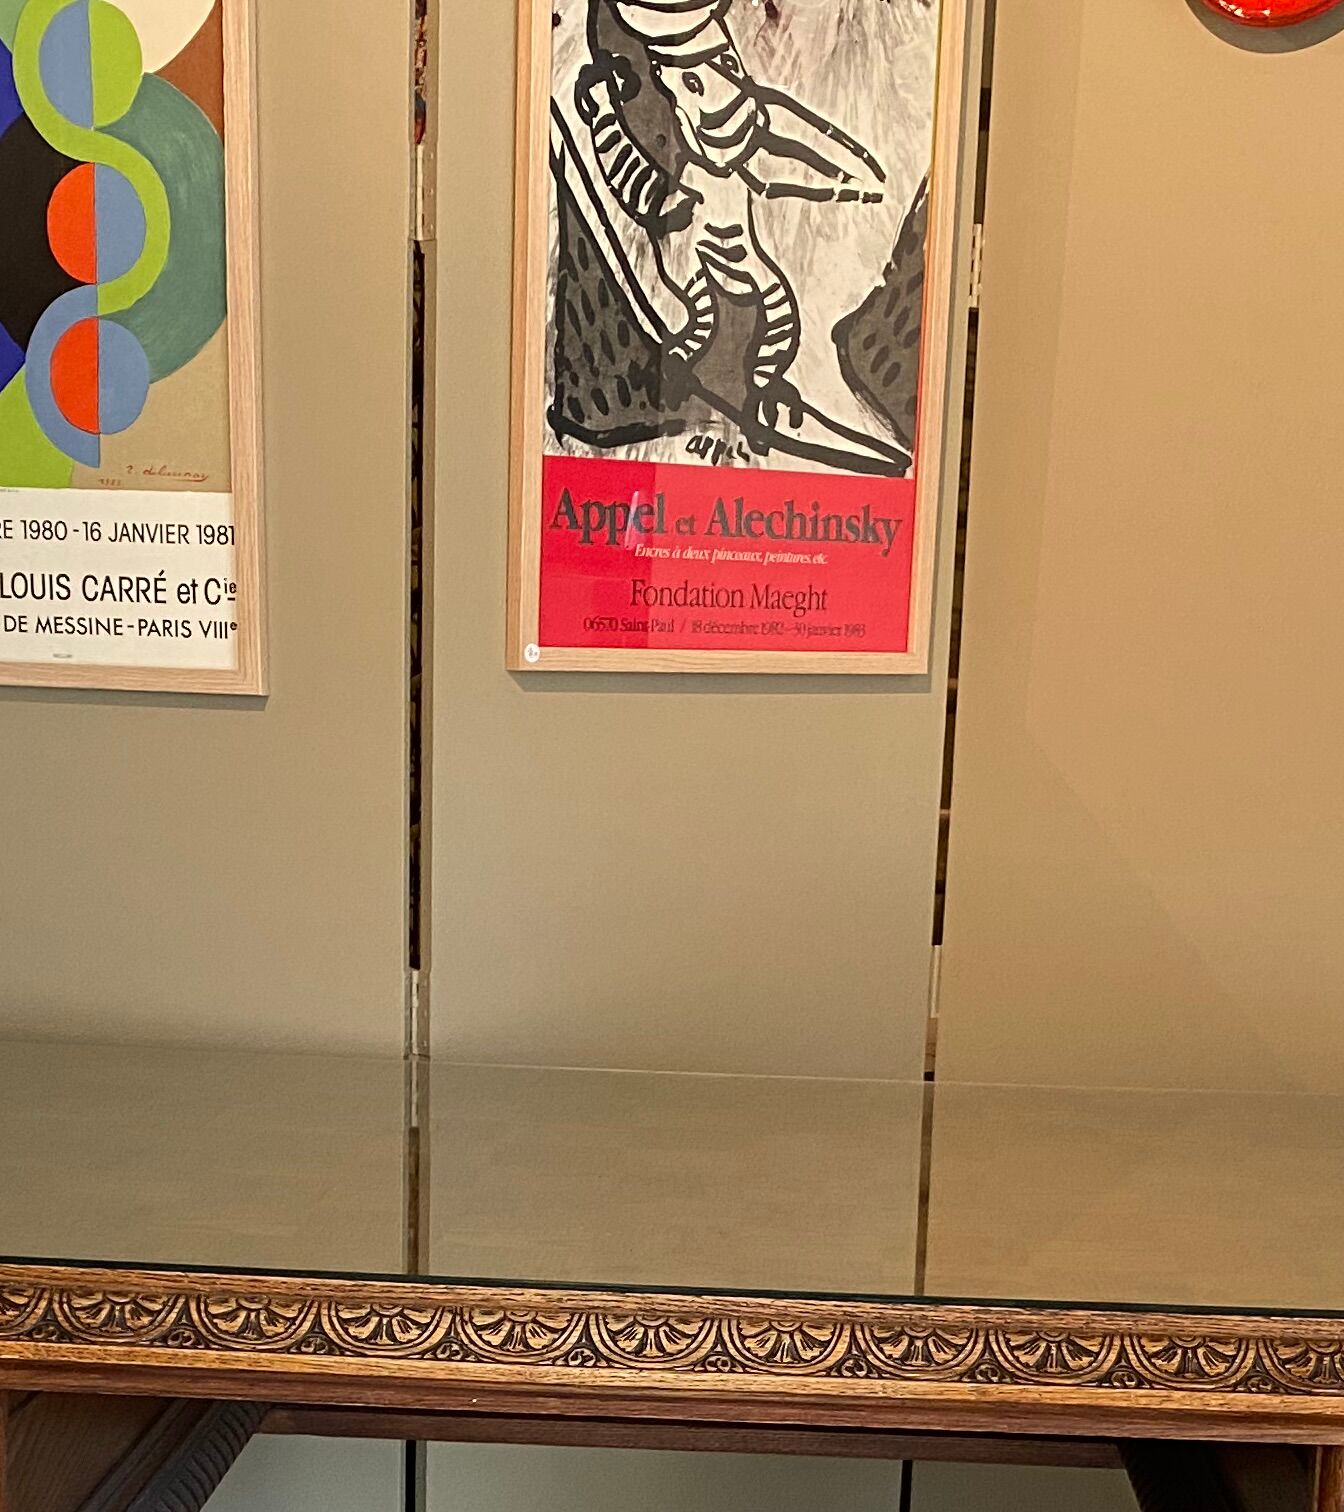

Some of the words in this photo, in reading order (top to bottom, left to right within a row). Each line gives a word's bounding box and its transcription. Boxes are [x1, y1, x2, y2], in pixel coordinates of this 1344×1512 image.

[20, 520, 67, 541] 1980
[108, 523, 189, 544] JANVIER
[196, 525, 235, 546] 1981
[550, 487, 668, 546] Appel
[674, 516, 697, 535] et
[705, 496, 902, 557] Alechinsky
[635, 544, 670, 558] Encres
[682, 547, 710, 561] deux
[0, 572, 71, 600] LOUIS
[81, 569, 166, 604] CARRÉ
[176, 583, 199, 605] et
[204, 577, 237, 605] Cie
[630, 579, 744, 609] Fondation
[751, 584, 828, 617] Maeght
[3, 616, 27, 633] DE
